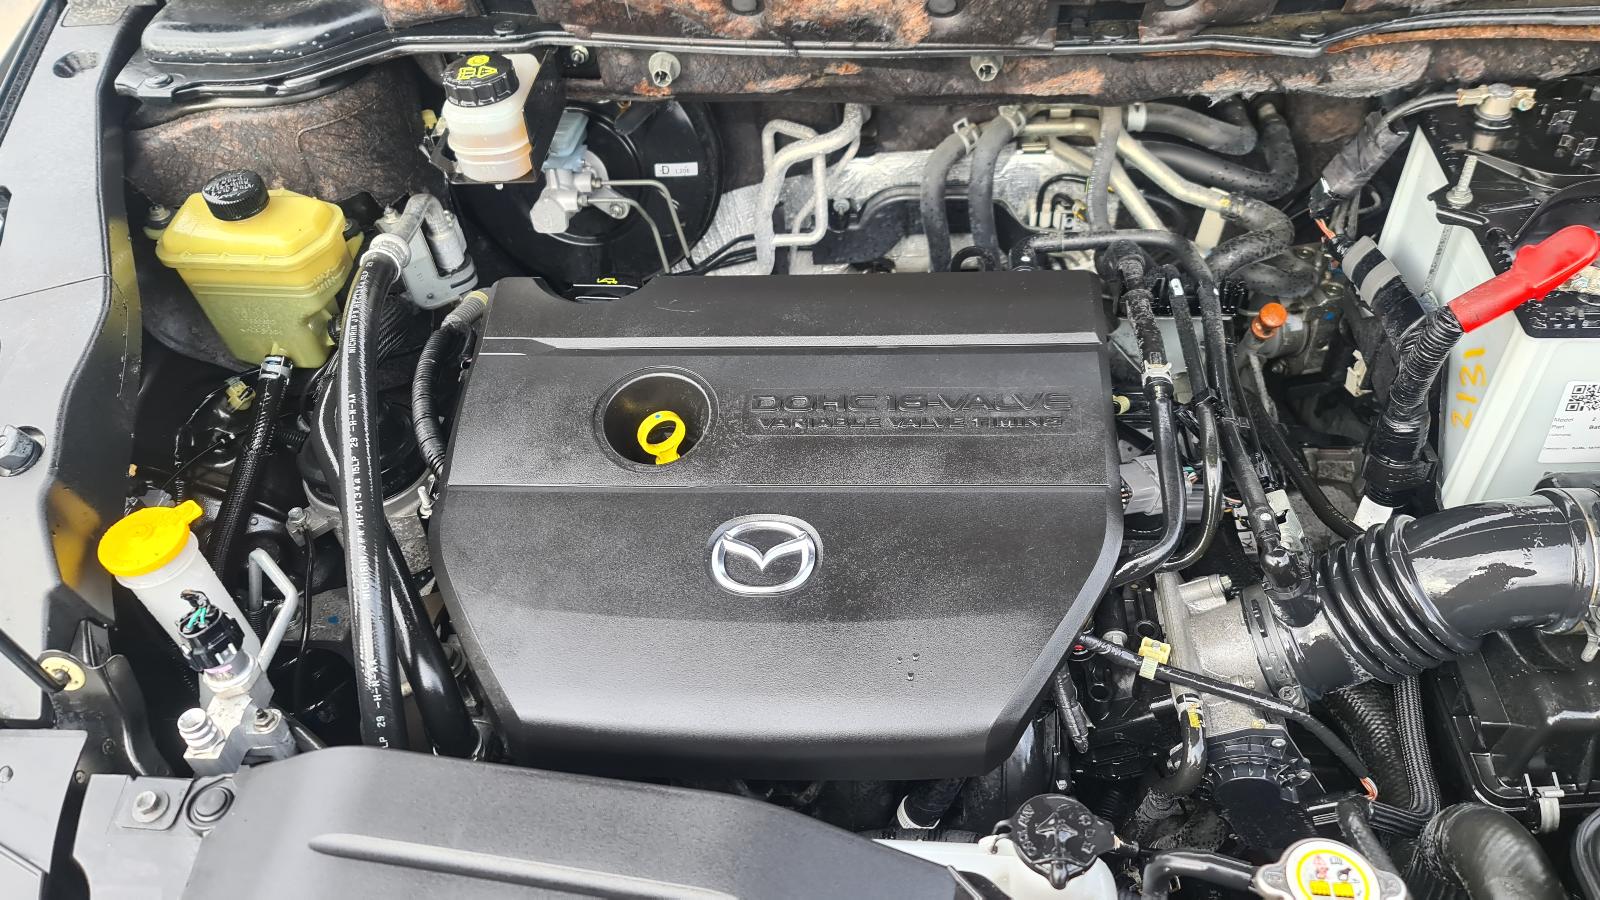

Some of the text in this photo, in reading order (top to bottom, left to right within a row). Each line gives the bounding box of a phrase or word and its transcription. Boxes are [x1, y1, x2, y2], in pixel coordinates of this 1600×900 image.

[662, 165, 670, 175] D
[348, 324, 359, 354] NICHIRIN
[1450, 346, 1488, 430] 2131
[750, 393, 1072, 412] DOHC 16-VALVE
[757, 416, 882, 429] VARIABLE
[885, 416, 965, 429] VALVE
[349, 437, 359, 448] 29
[360, 555, 371, 600] NICHIRIN
[376, 715, 386, 728] 29
